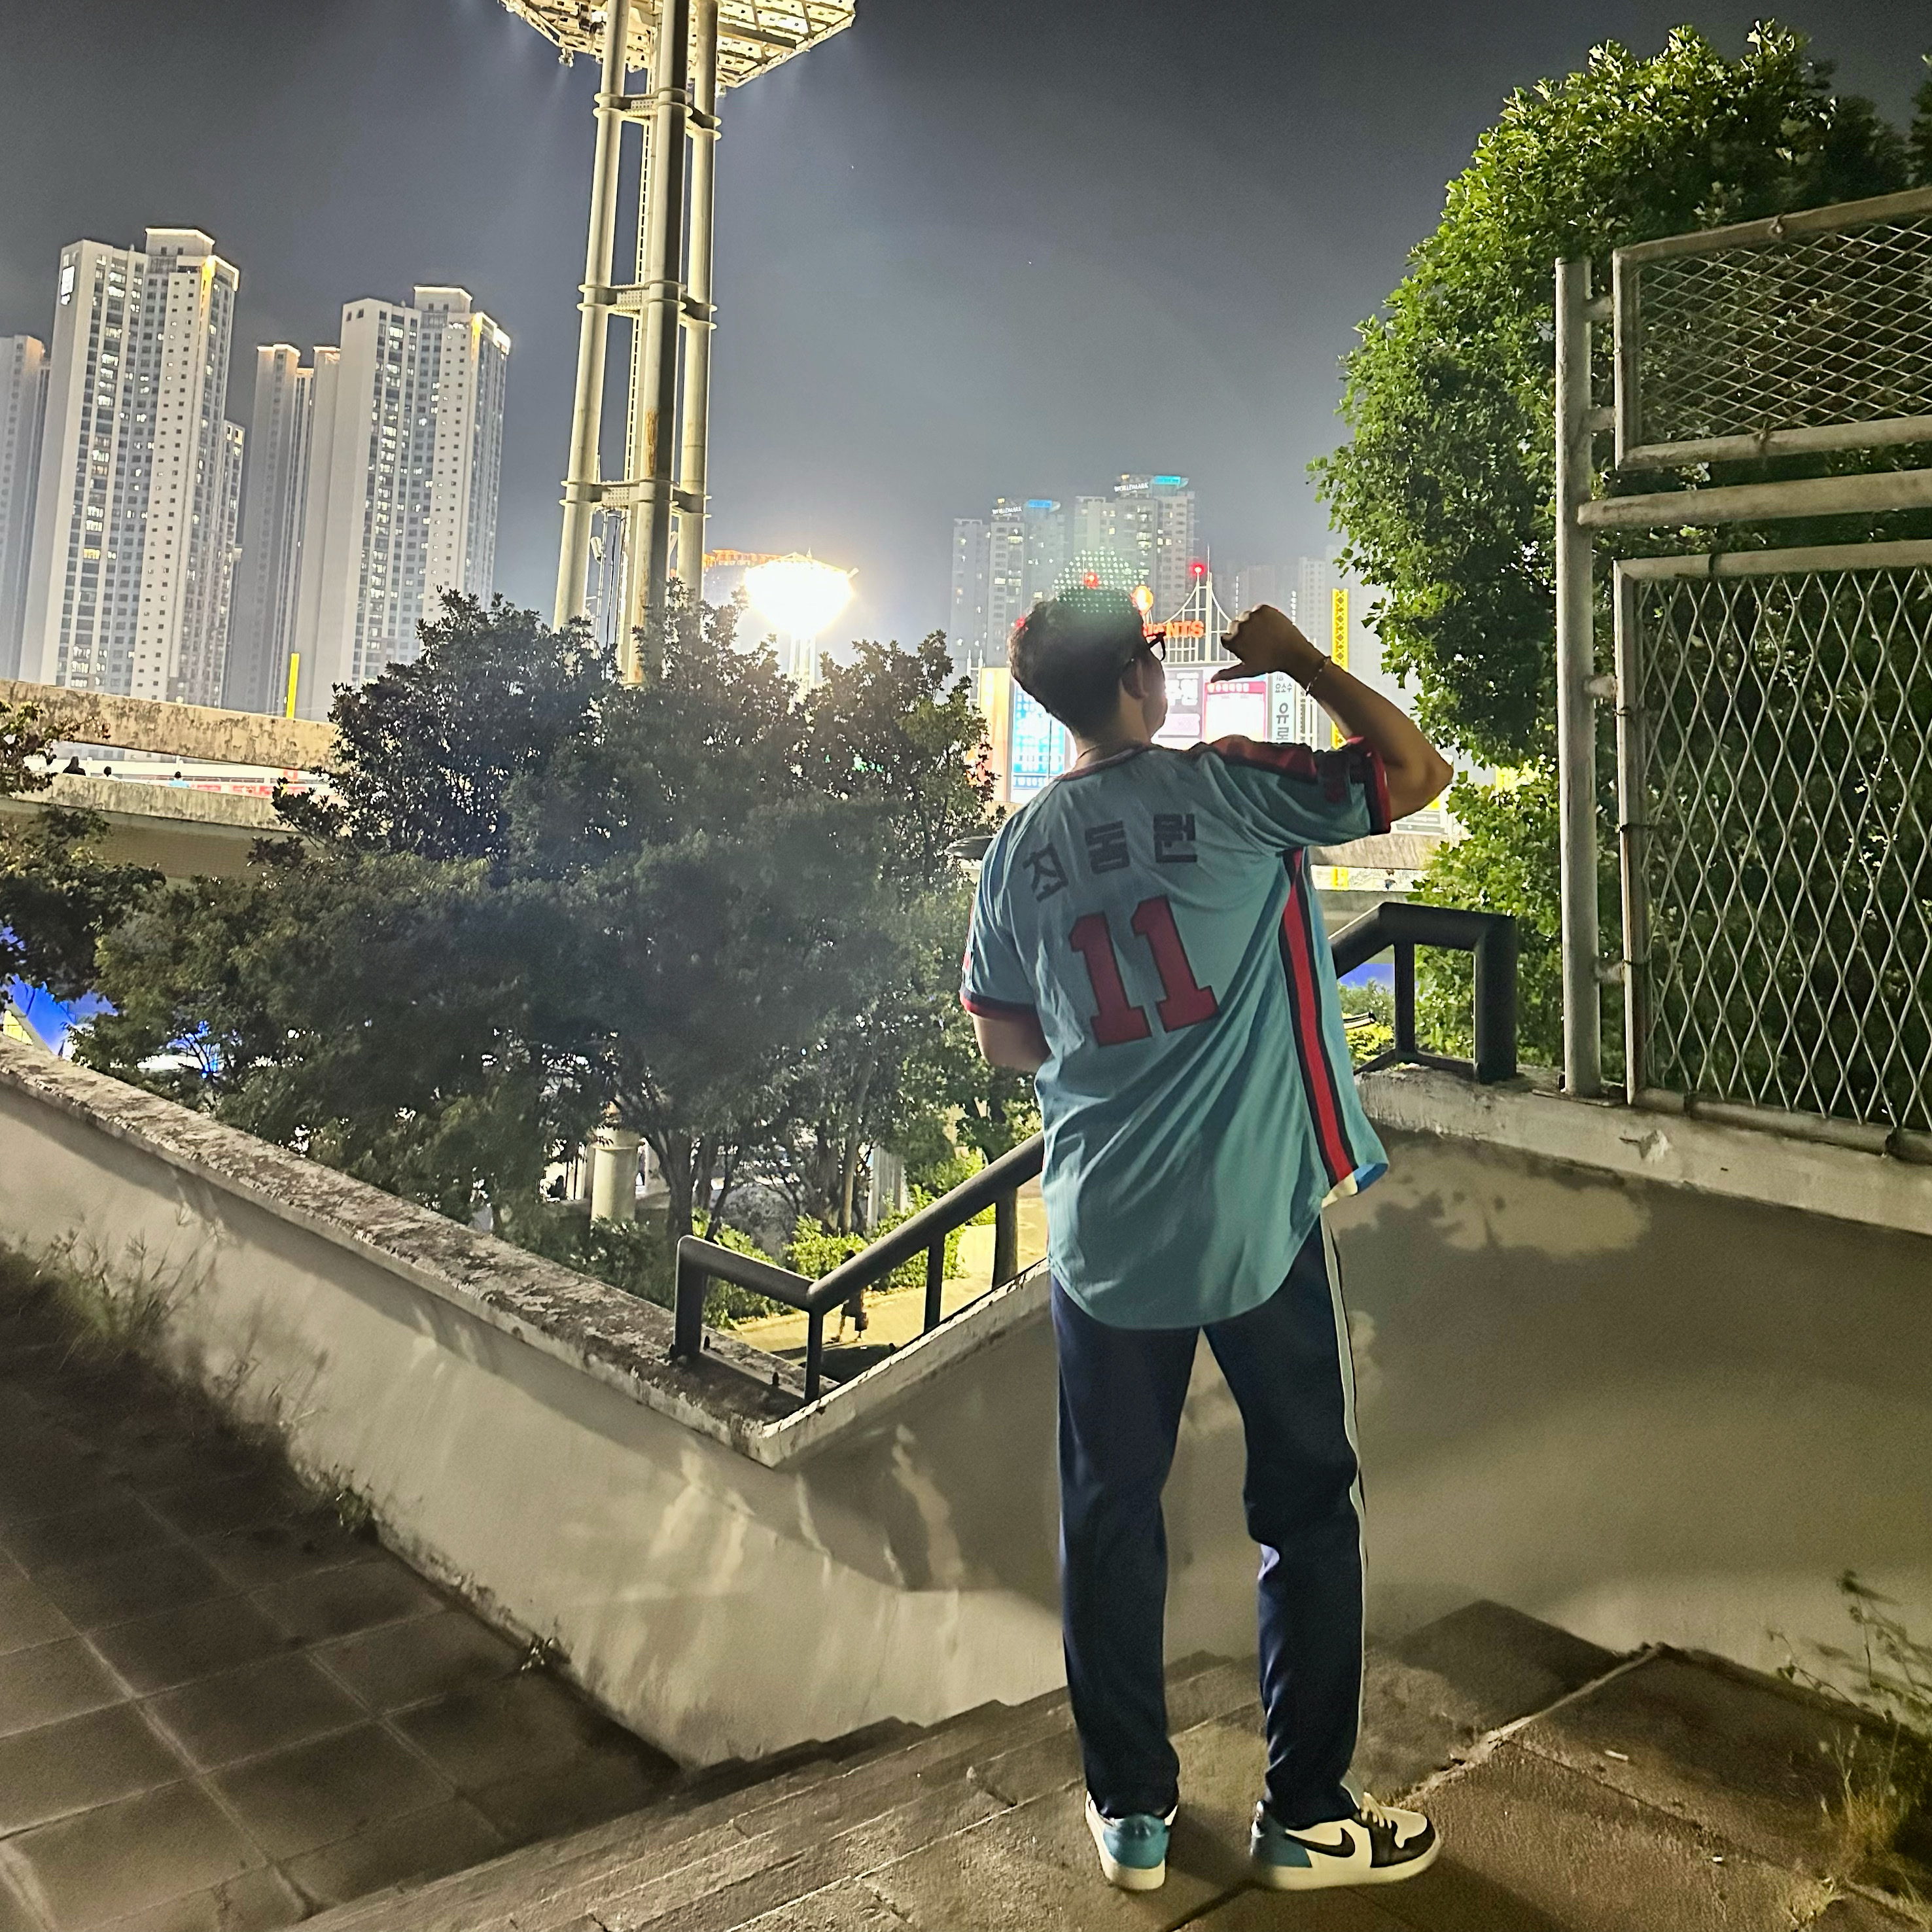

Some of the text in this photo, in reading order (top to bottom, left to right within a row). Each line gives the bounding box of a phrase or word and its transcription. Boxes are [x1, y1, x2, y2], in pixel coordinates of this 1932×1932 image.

[1114, 482, 1149, 492] WORLDMARK
[992, 506, 1022, 515] WORLDMARK
[1142, 621, 1204, 639] IANTS
[1275, 683, 1293, 694] 요소수
[1068, 895, 1220, 1047] 11
